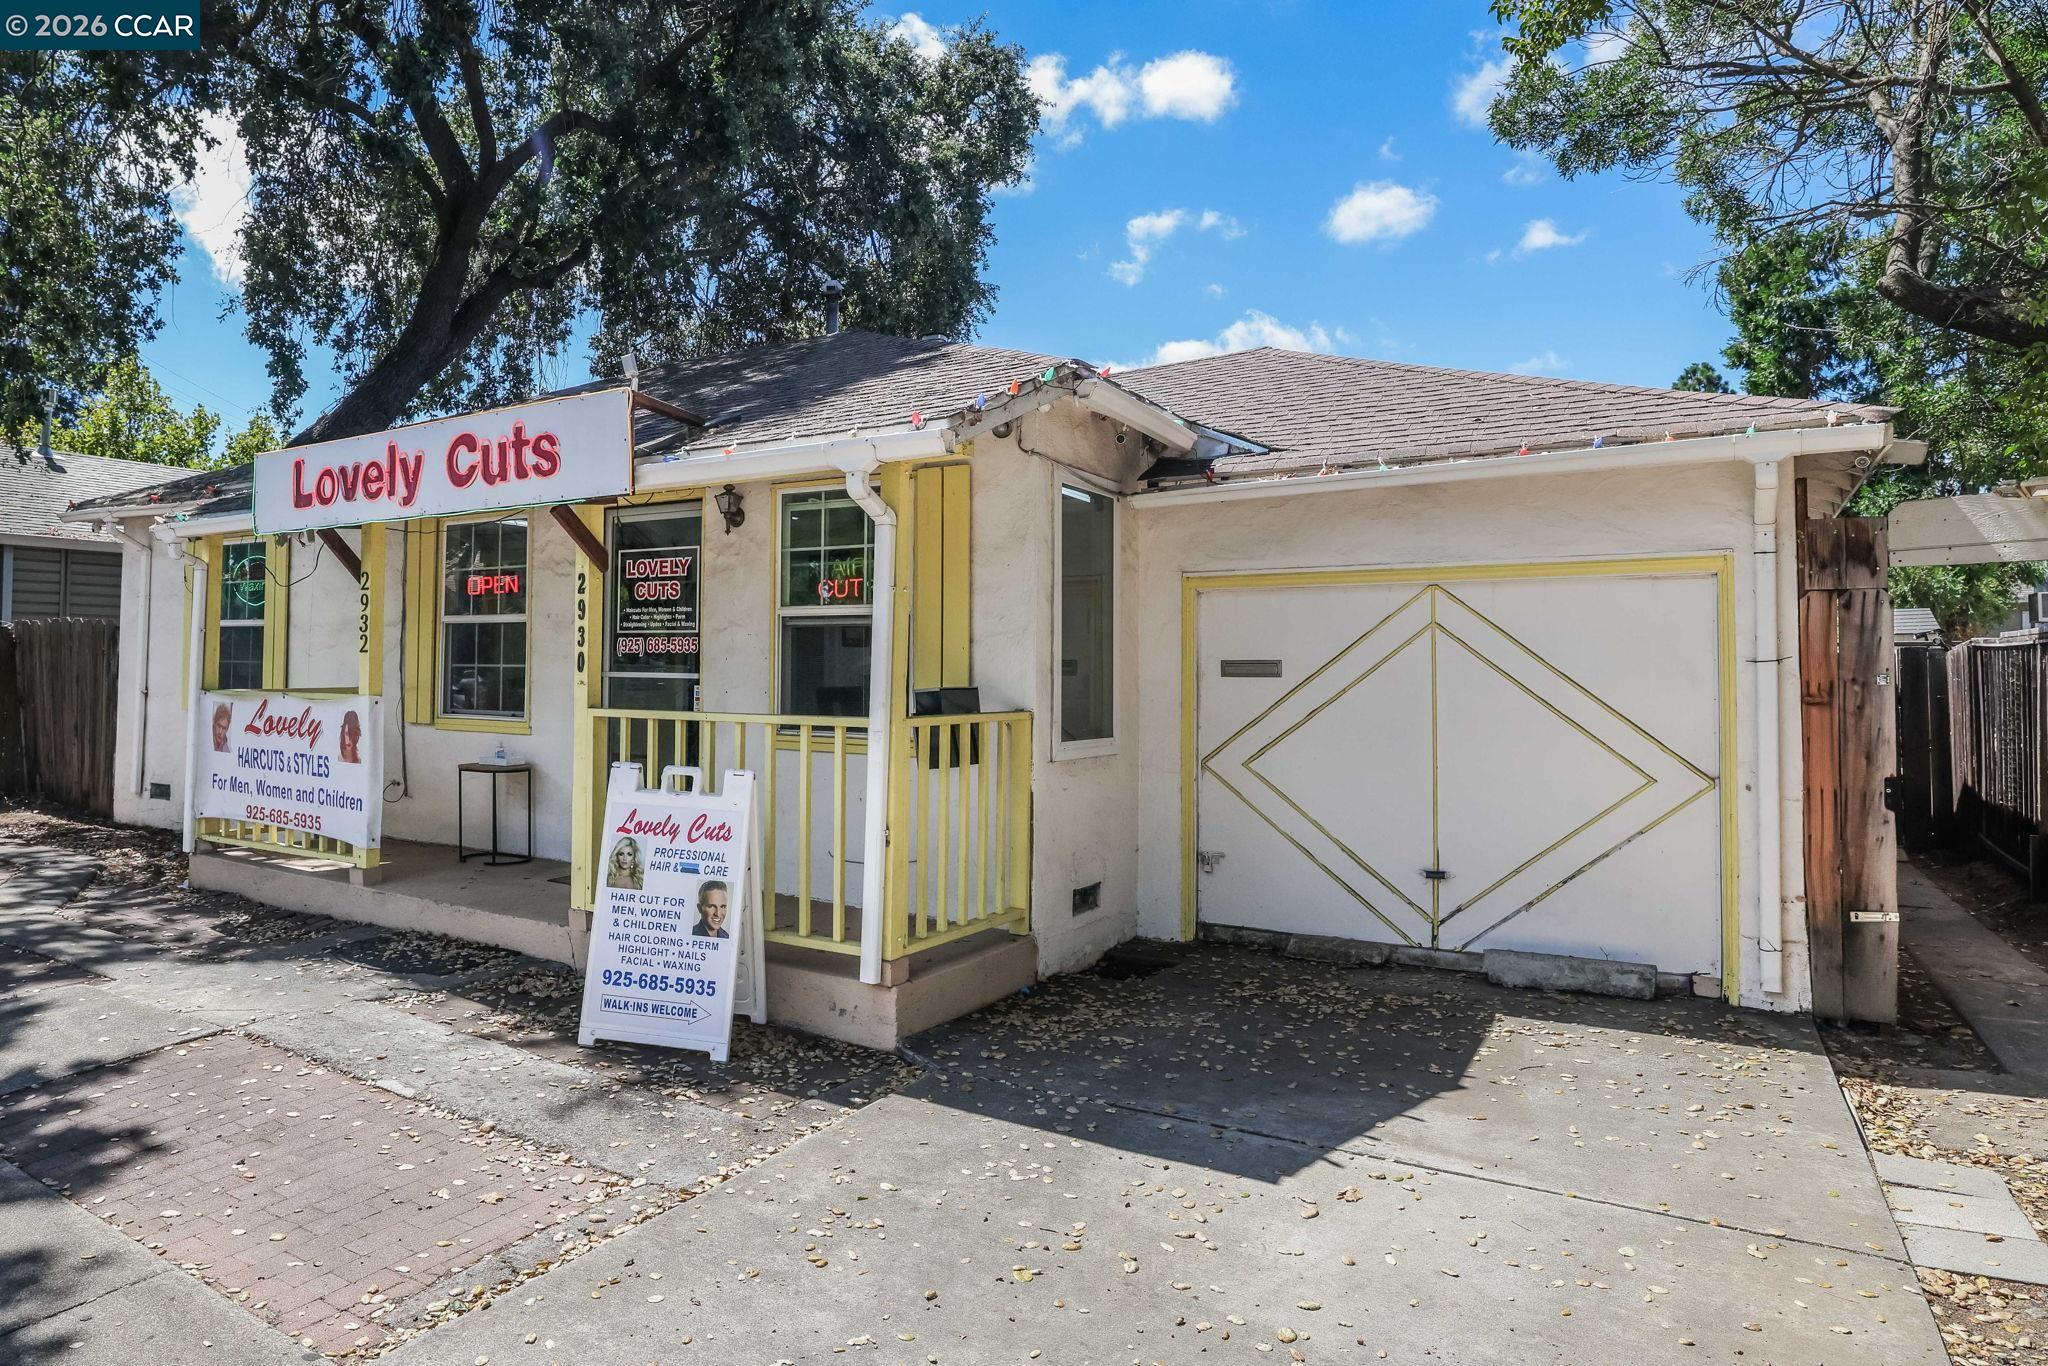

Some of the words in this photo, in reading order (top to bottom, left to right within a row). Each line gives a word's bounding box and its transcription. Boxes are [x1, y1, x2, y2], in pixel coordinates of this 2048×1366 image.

[291, 438, 425, 509] Lovely
[446, 420, 562, 489] Cuts
[626, 556, 692, 578] LOVELY
[467, 575, 519, 595] OPEN
[634, 580, 681, 600] CUTS
[818, 578, 864, 598] CUT
[359, 571, 369, 653] 2932
[577, 572, 587, 673] 2930
[617, 637, 645, 657] (925)
[647, 637, 699, 653] 685-5935
[244, 698, 323, 750] Lovely
[237, 746, 285, 773] HAIRCUTS
[286, 756, 292, 773] &
[294, 752, 330, 778] STYLES
[212, 773, 228, 790] For
[229, 776, 253, 798] Men,
[256, 779, 293, 800] Women
[295, 787, 315, 804] and
[318, 787, 363, 812] Children
[245, 804, 322, 831] 925-685-5935
[616, 808, 681, 845] Lovely
[687, 813, 734, 844] Cuts
[654, 847, 726, 863] PROFESSIONAL
[649, 860, 672, 872] HAIR
[672, 862, 679, 873] &
[703, 864, 729, 877] CARE
[610, 892, 636, 903] HAIR
[639, 895, 660, 905] CUT
[663, 896, 685, 908] FOR
[612, 905, 637, 917] MEN,
[641, 908, 681, 920] WOMEN
[612, 918, 620, 928] &
[623, 919, 678, 932] CHILDREN
[608, 932, 631, 942] HAIR
[633, 934, 684, 948] COLORING
[692, 940, 720, 951] PERM
[618, 944, 669, 958] HIGHLIGHT
[678, 950, 706, 961] NAILS
[621, 956, 654, 968] FACIAL
[663, 961, 701, 972] WAXING
[602, 969, 717, 997] 925-685-5935
[603, 998, 649, 1013] WALK-INS
[651, 1003, 698, 1019] WELCOME
